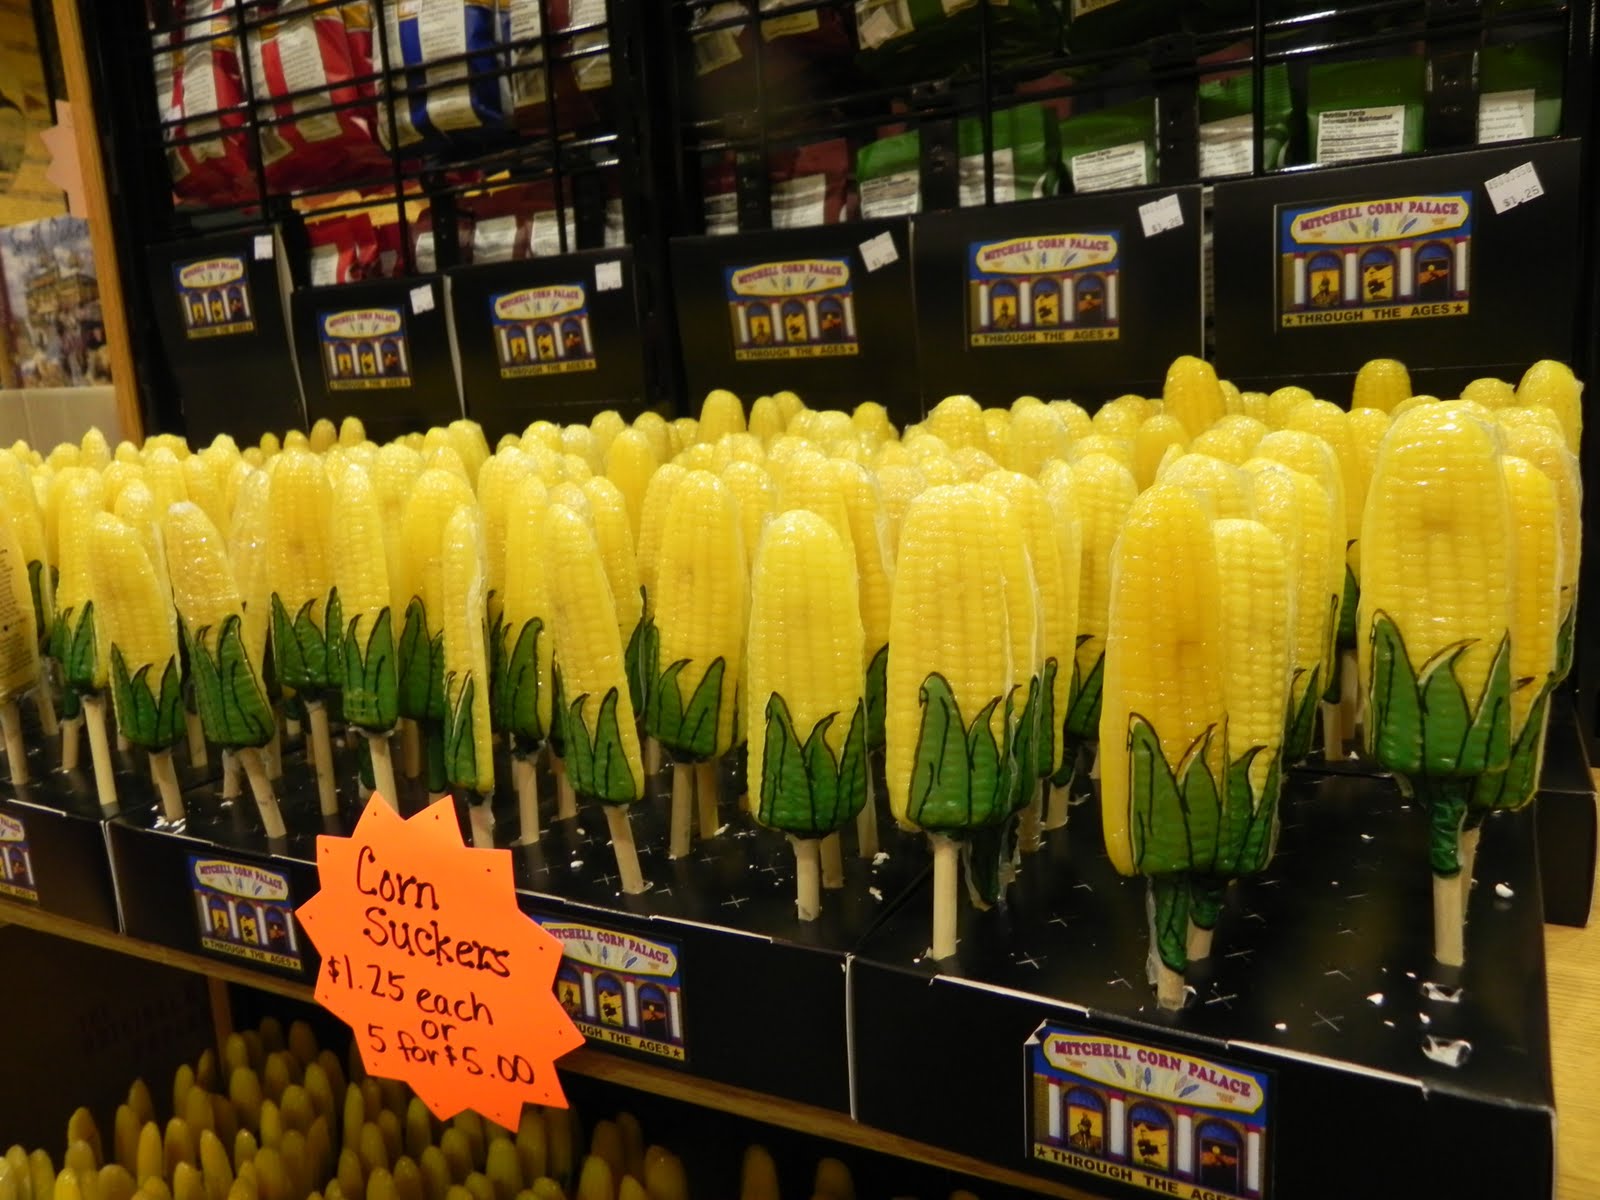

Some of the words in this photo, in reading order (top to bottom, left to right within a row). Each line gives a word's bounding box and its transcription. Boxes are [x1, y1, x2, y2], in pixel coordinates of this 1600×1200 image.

[1503, 185, 1540, 208] $1.25
[1299, 207, 1363, 232] MITCHELL
[1367, 201, 1403, 215] CORN
[1408, 201, 1460, 215] PALACE
[984, 241, 1034, 262] MITCHELL
[1037, 238, 1066, 250] CORN
[1069, 238, 1110, 252] PALACE
[1297, 310, 1364, 325] THROUGH
[1373, 307, 1402, 319] THE
[1411, 304, 1450, 317] AGES
[983, 332, 1036, 344] THROUGH
[1043, 331, 1065, 341] THE
[1073, 329, 1104, 340] AGES
[357, 845, 440, 911] Corn
[363, 906, 511, 978] Suckers
[597, 931, 625, 947] CORN
[629, 939, 669, 964] PALACE
[327, 954, 406, 1002] $1.25
[416, 988, 494, 1026] each
[367, 1023, 387, 1054] 5
[397, 1030, 440, 1066] for
[420, 1019, 457, 1042] or
[609, 1031, 633, 1046] THE
[639, 1039, 670, 1056] AGES
[1054, 1040, 1131, 1060] MITCHELL
[1137, 1049, 1182, 1072] CORN
[1188, 1062, 1251, 1097] PALACE
[1051, 1149, 1133, 1182] THROUGH
[1143, 1174, 1179, 1195] THE
[1190, 1188, 1236, 1200] AG
